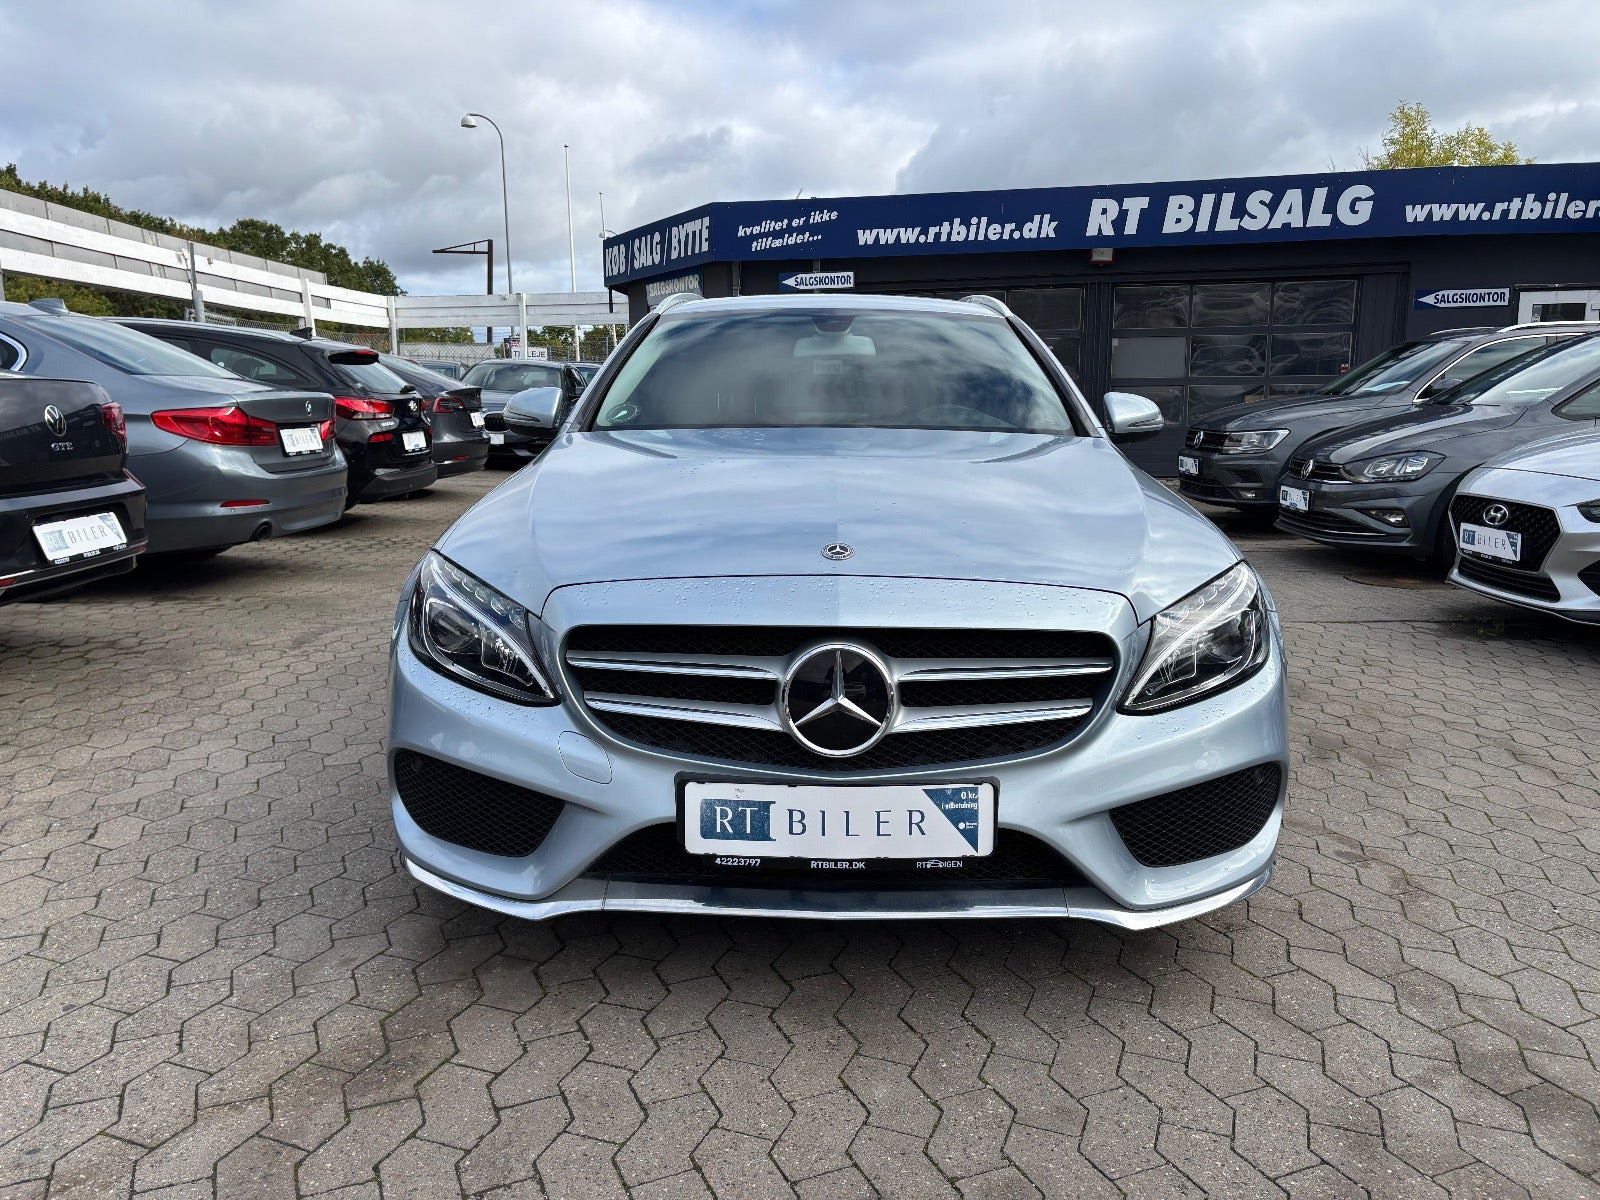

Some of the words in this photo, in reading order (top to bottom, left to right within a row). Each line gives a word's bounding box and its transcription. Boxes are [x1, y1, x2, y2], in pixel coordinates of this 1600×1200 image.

[1085, 196, 1150, 237] RT
[1162, 184, 1375, 234] BILSALG
[1405, 192, 1600, 223] www.rtbiler
[737, 218, 789, 237] kvalitet
[792, 216, 806, 228] er
[809, 209, 838, 224] ikke
[857, 213, 1059, 245] www.rtbiler.dk
[605, 243, 626, 277] KØB
[633, 231, 661, 270] SALG
[670, 216, 710, 260] BYTTE
[751, 231, 822, 252] tilfældet...
[649, 274, 699, 297] SALGSKONTOR
[794, 274, 852, 287] SALGSKONTOR
[1433, 291, 1506, 305] SALGSKONTOR
[51, 441, 74, 451] GTE
[67, 525, 108, 544] BILER
[960, 791, 967, 800] 0
[714, 805, 759, 834] RT
[787, 808, 927, 837] BILER
[714, 857, 761, 867] 42223797
[811, 860, 866, 869] RTBILER.DK
